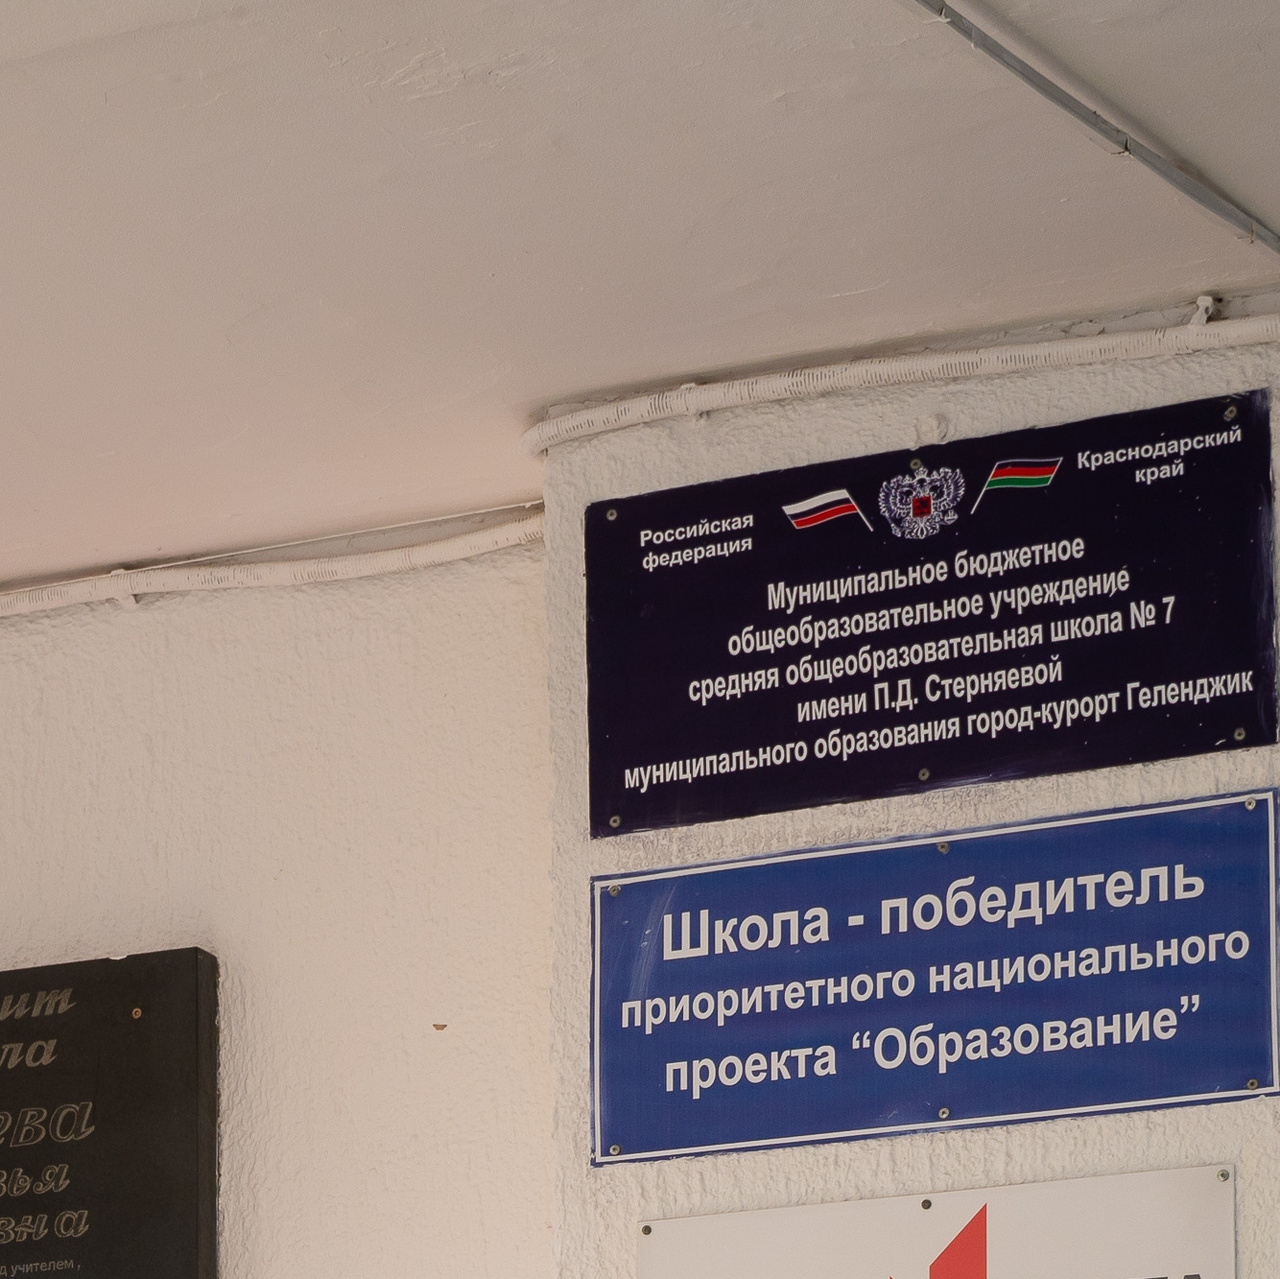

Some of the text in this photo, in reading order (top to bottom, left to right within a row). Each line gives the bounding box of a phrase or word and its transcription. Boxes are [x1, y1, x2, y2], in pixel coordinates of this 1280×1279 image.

[1078, 425, 1241, 470] Краснодарский
[1136, 459, 1184, 484] край
[640, 515, 753, 546] Российская
[643, 538, 752, 572] федерация
[728, 566, 1129, 655] общеобразовательное учреждение
[768, 538, 1084, 614] Муниципальное бюджетное
[689, 596, 1175, 706] средняя общеобразовательная школа № 7
[798, 654, 1062, 722] имени П.Д. Стерняевой
[625, 671, 1253, 793] муниципального образования город-курорт Геленджик
[664, 908, 829, 960] Школа
[882, 864, 1204, 934] победитель
[622, 931, 1249, 1034] приоритетного национального
[666, 1046, 836, 1099] проекта
